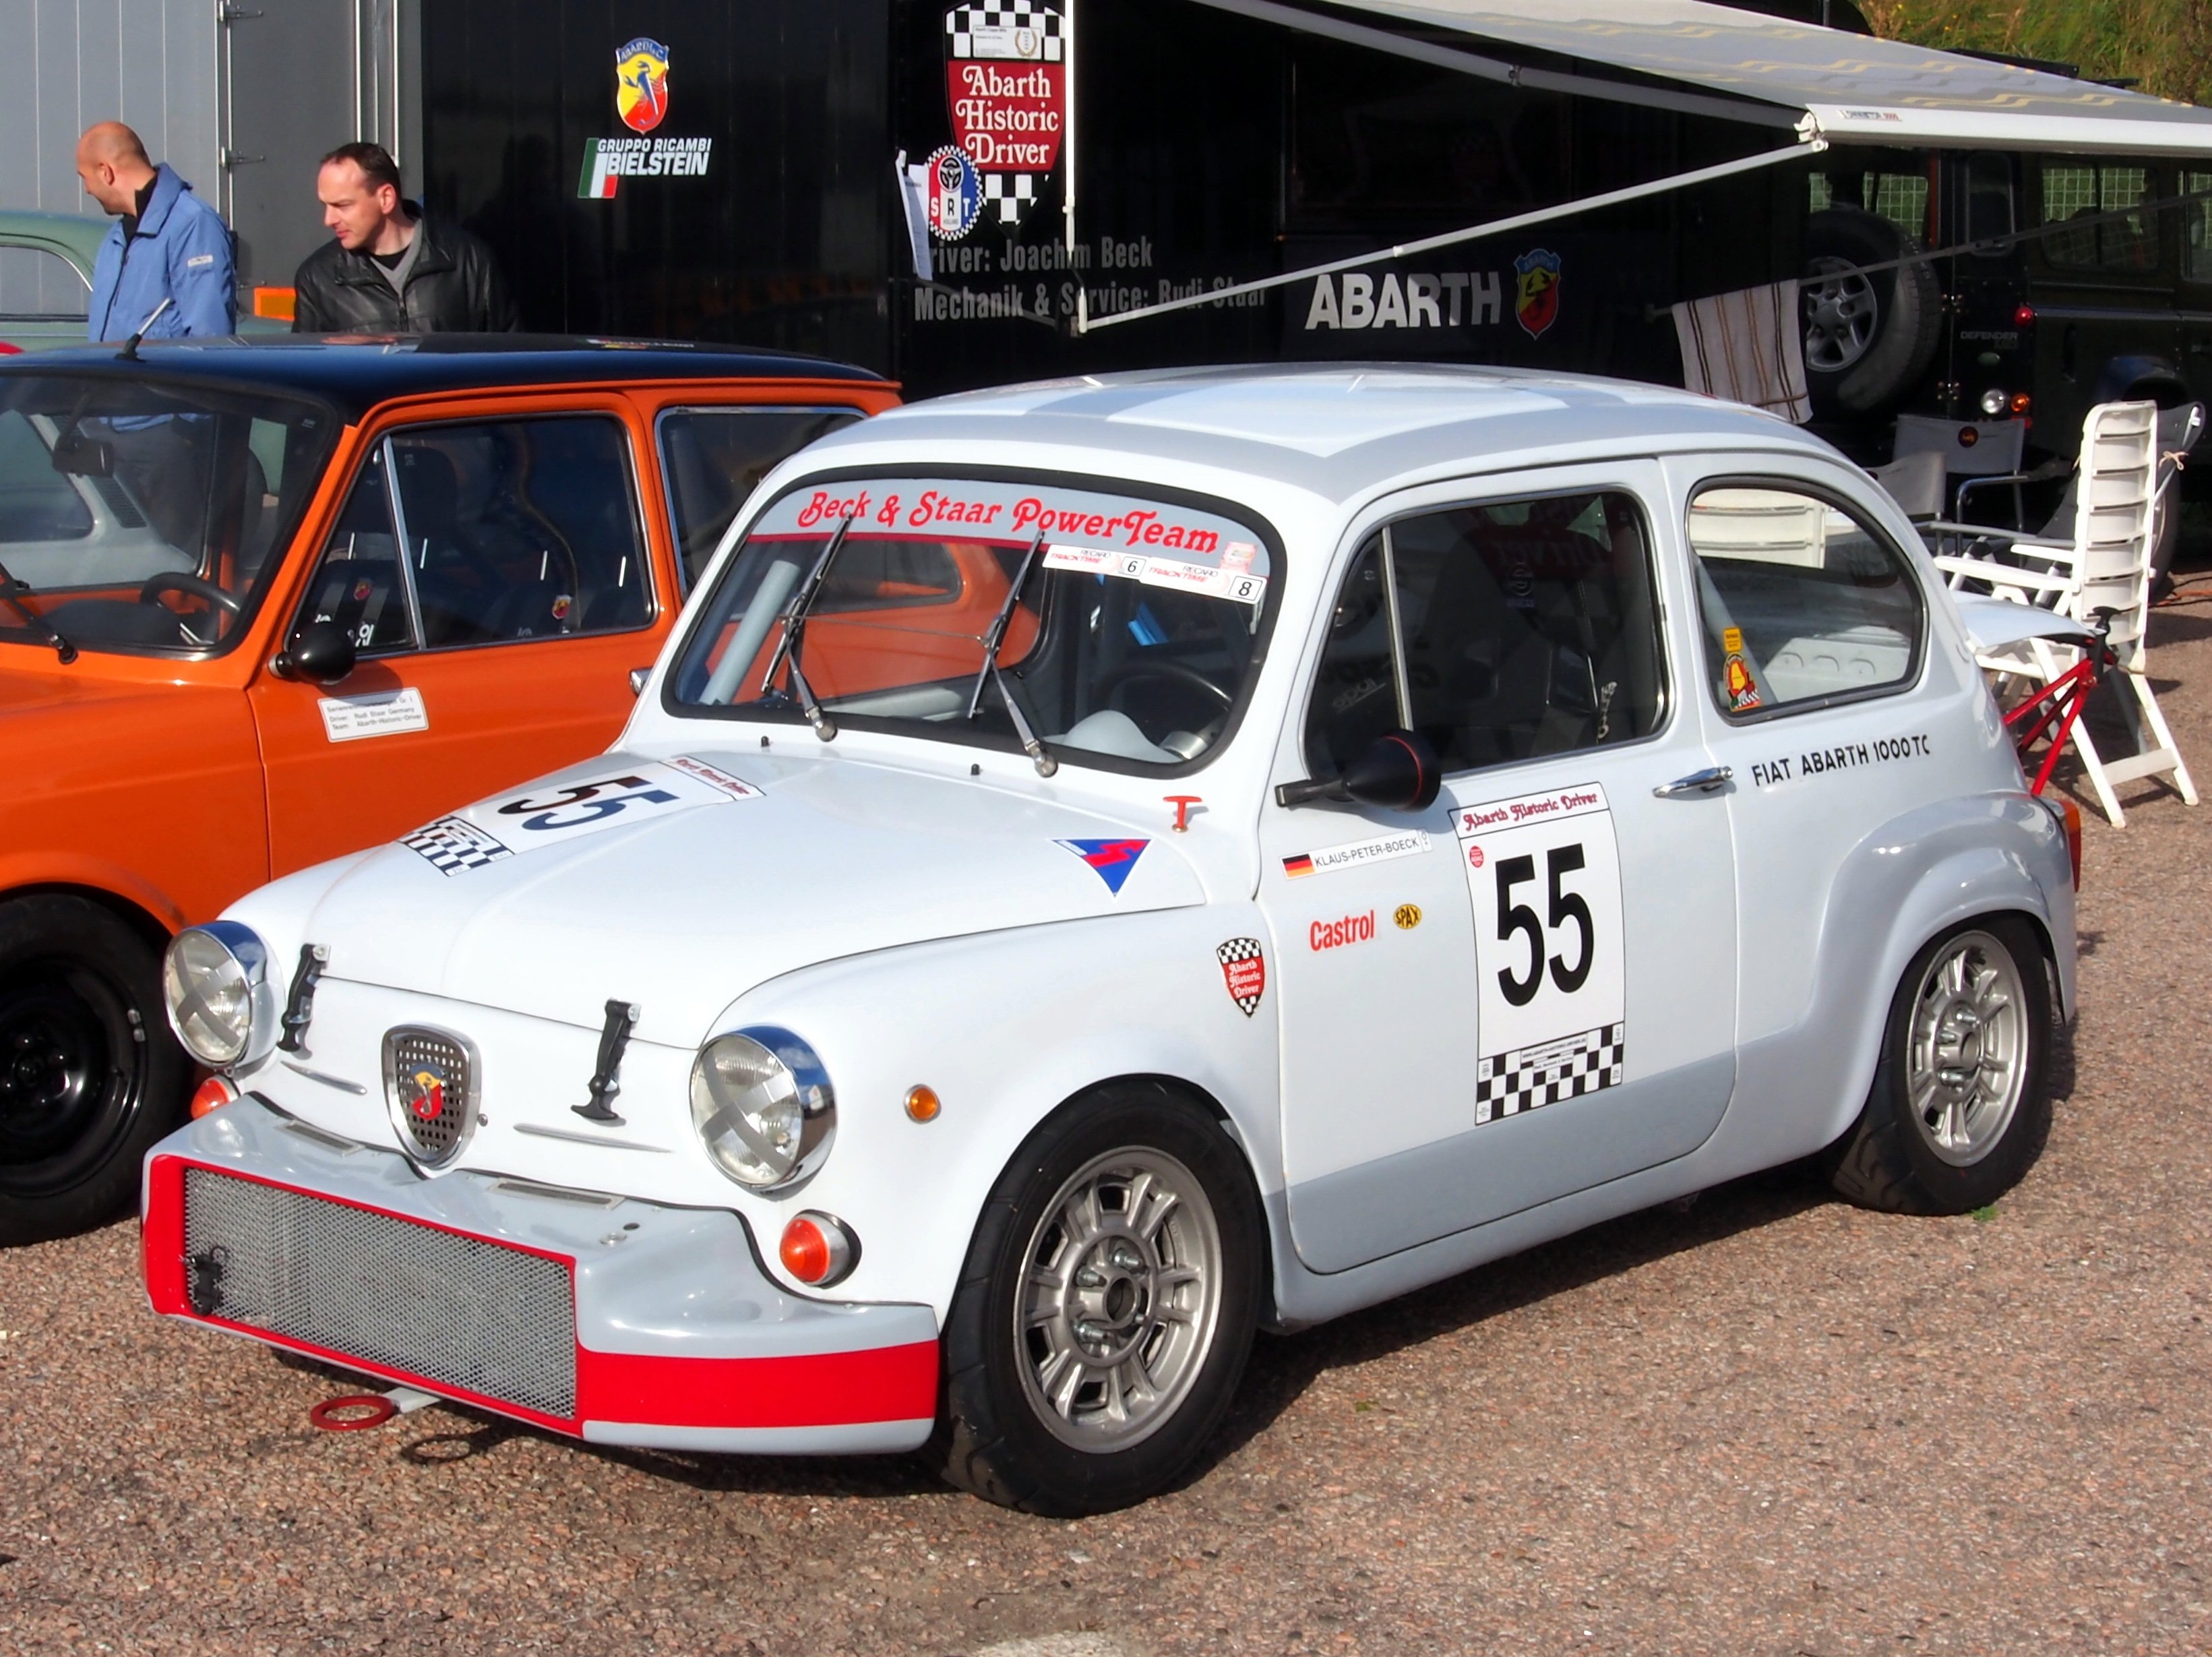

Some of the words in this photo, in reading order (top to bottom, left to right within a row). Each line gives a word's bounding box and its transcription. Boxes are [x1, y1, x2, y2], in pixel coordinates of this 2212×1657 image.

[962, 65, 1051, 98] Abarth
[955, 98, 1059, 132] Historic
[597, 138, 651, 152] GRUPPO
[654, 138, 712, 152] RICAMBI
[964, 133, 1050, 164] Driver
[607, 152, 710, 175] BIELSTEIN
[913, 241, 990, 274] river:
[1101, 235, 1153, 268] Beck
[915, 284, 1024, 321] Mechanik
[1034, 283, 1050, 316] &
[1061, 281, 1148, 315] Srvice:
[1305, 271, 1502, 330] ABARTH
[1960, 331, 2017, 340] DEFENDER
[797, 490, 871, 528] Beck
[877, 495, 900, 528] &
[909, 491, 1003, 527] Staar
[1127, 560, 1138, 573] 6
[1237, 581, 1253, 597] 8
[1751, 758, 1791, 787] FIAT
[1801, 744, 1870, 776] ABARTH
[497, 775, 681, 831] 55
[1463, 808, 1508, 831] Abarth
[1509, 797, 1559, 822] Historic
[1560, 791, 1598, 811] Driver
[1314, 837, 1420, 868] KLAUS-PETER-BOECK
[1310, 909, 1375, 951] Castrol
[1395, 907, 1420, 928] SPAX
[1495, 843, 1594, 1006] 55
[1229, 960, 1258, 976] Abarth
[1229, 971, 1262, 989] Historic
[1233, 984, 1260, 999] Driver
